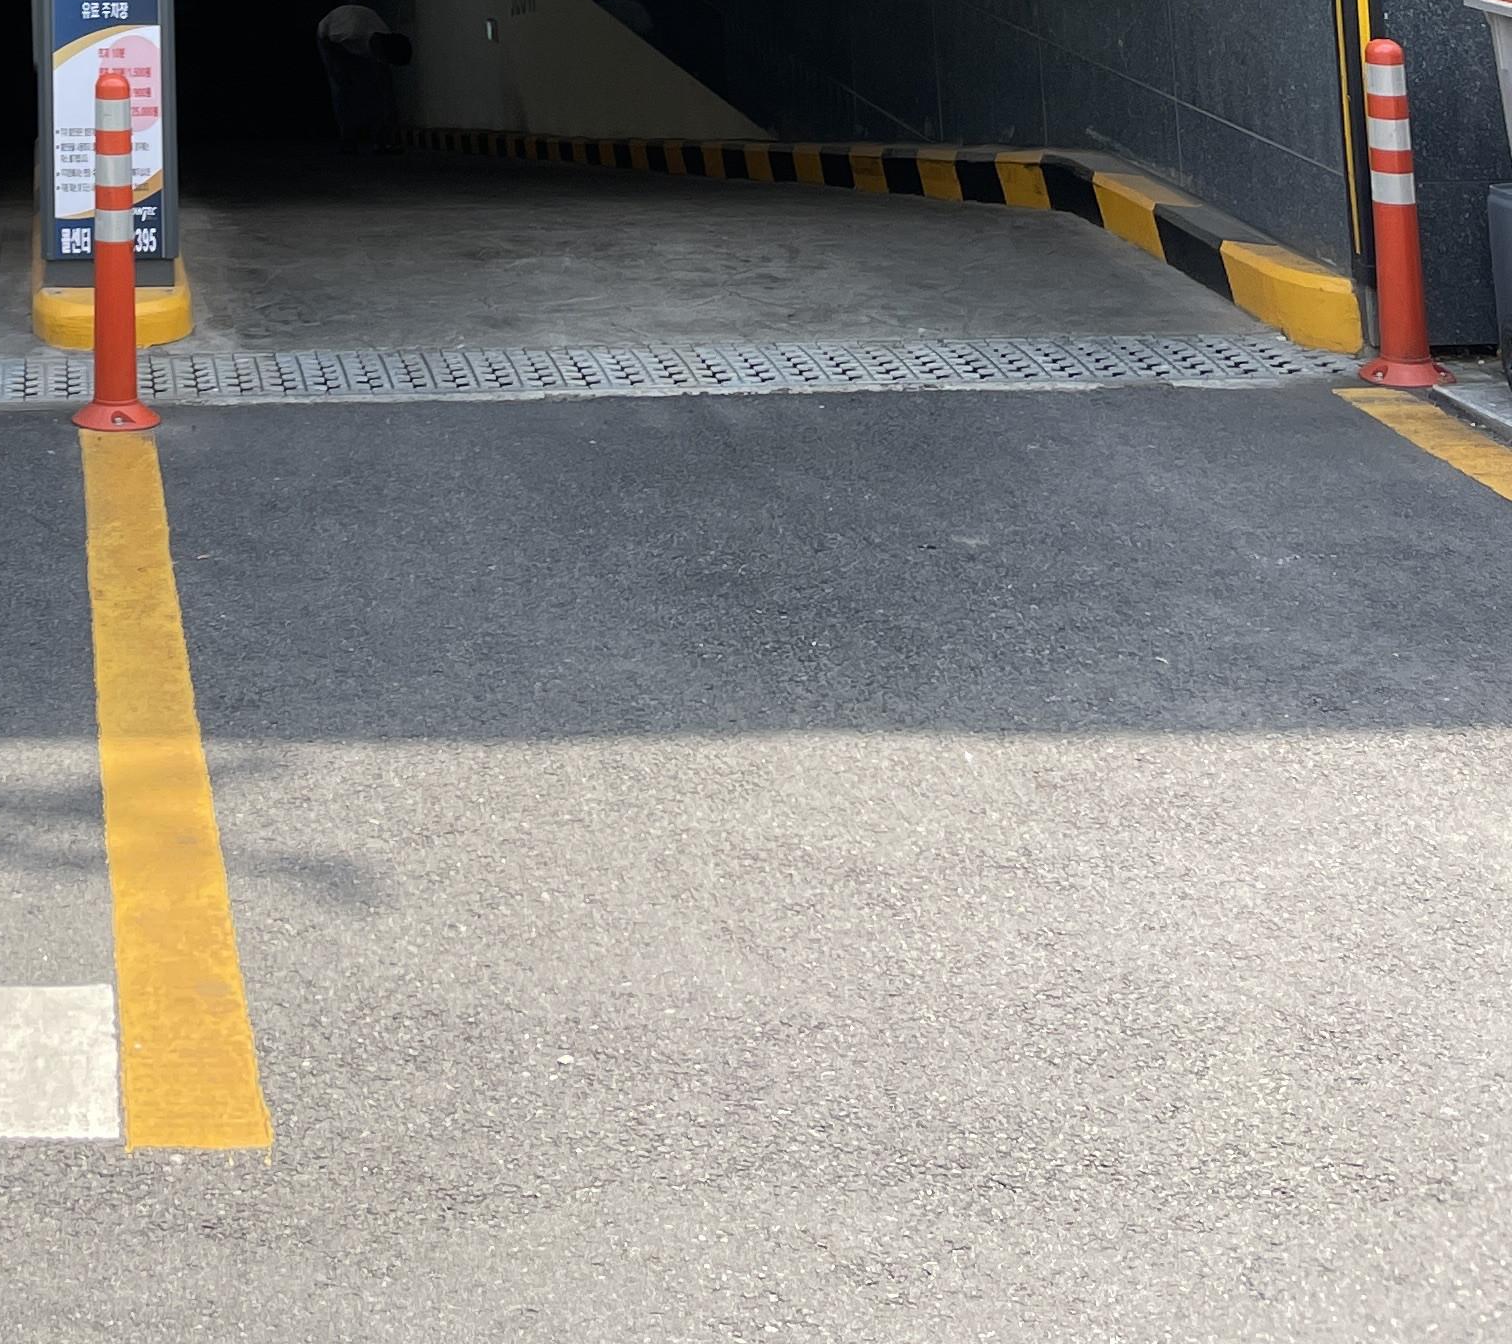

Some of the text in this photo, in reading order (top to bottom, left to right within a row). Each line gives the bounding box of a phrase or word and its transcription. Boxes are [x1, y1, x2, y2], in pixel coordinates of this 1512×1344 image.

[81, 2, 129, 19] 유료 주차장
[133, 227, 157, 253] 395
